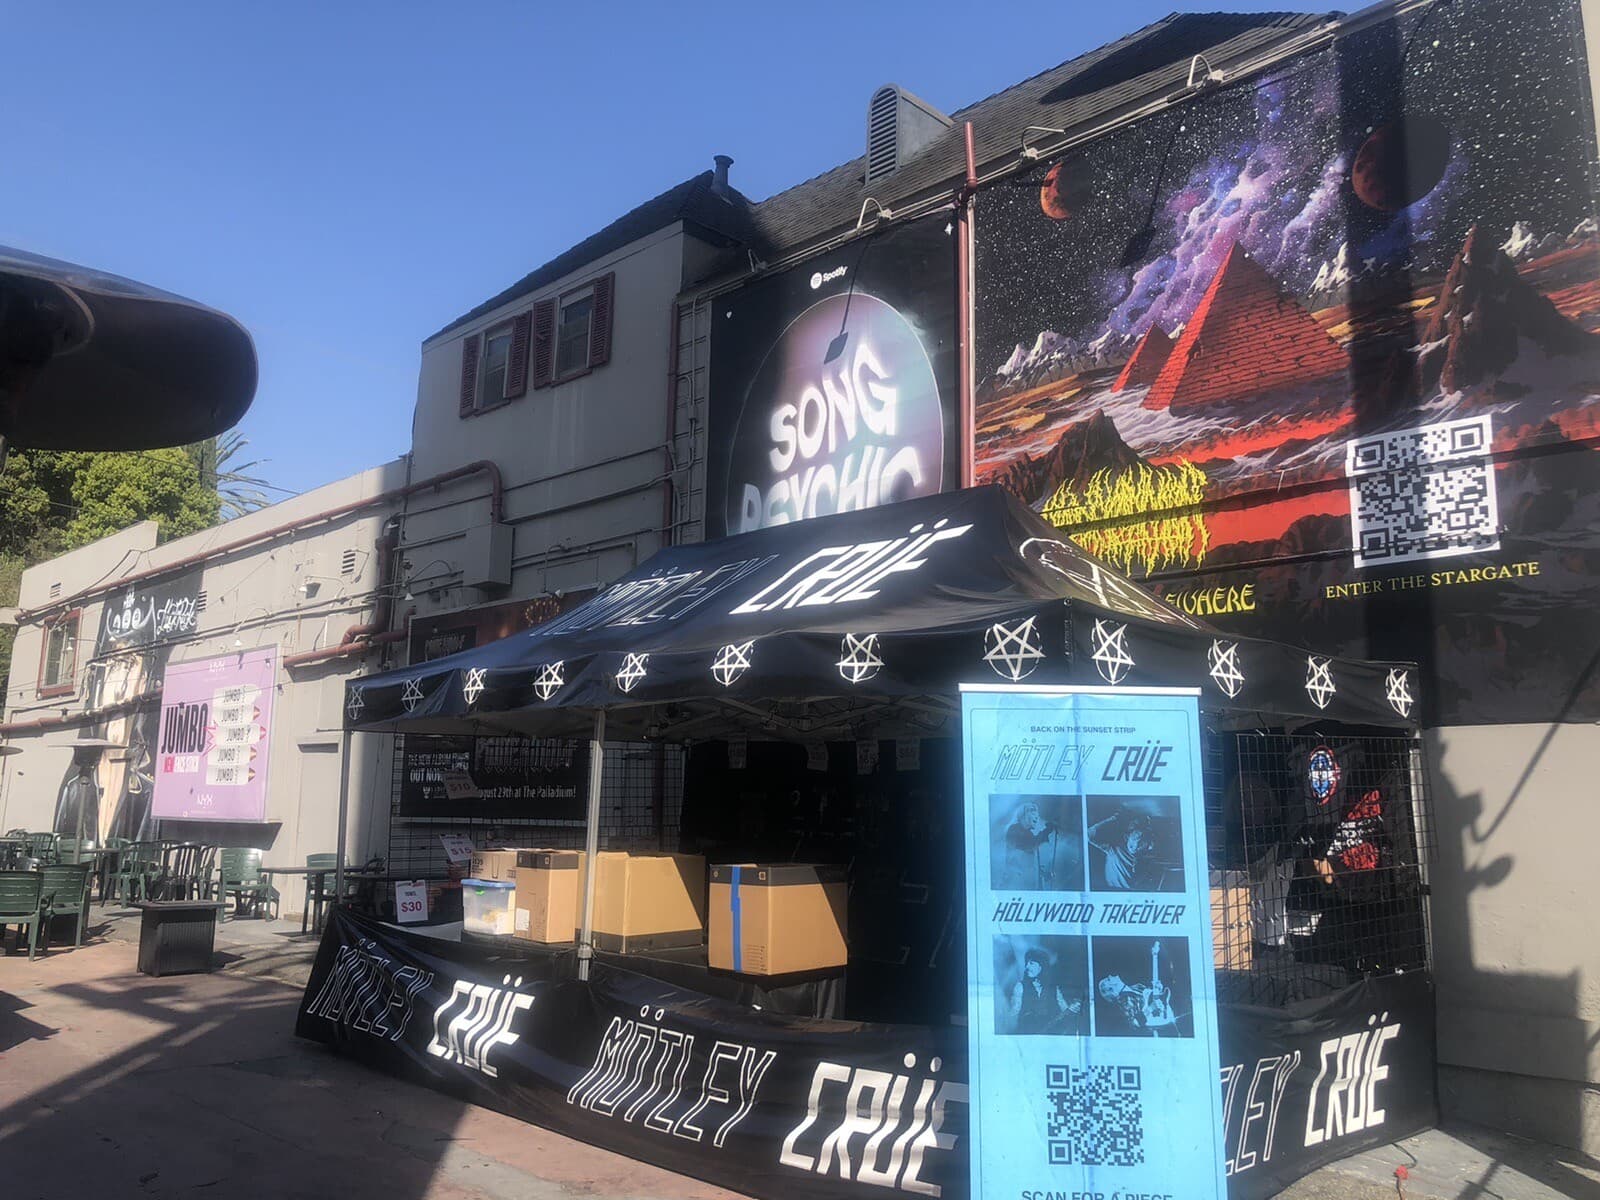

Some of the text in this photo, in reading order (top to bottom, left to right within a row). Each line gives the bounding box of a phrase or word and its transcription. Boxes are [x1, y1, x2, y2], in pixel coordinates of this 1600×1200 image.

[822, 265, 848, 282] Spotify
[768, 342, 897, 473] SONG
[729, 517, 974, 615] CRÜE
[1325, 561, 1540, 599] ENTER THE STARGATE
[161, 702, 209, 754] JUMBO
[221, 708, 240, 722] JUMBO
[1082, 726, 1112, 734] SUNSET
[217, 748, 236, 762] JUMBO
[990, 738, 1173, 783] MÖTLEY CRÜE
[216, 768, 234, 782] JUMBO
[401, 901, 422, 913] $30
[991, 897, 1186, 926] HÖLLYWOOD TAKEÖVER
[426, 973, 536, 1078] CRÜE
[1304, 1011, 1401, 1147] CRÜE
[567, 1004, 969, 1198] MÖTLEY CRÜE
